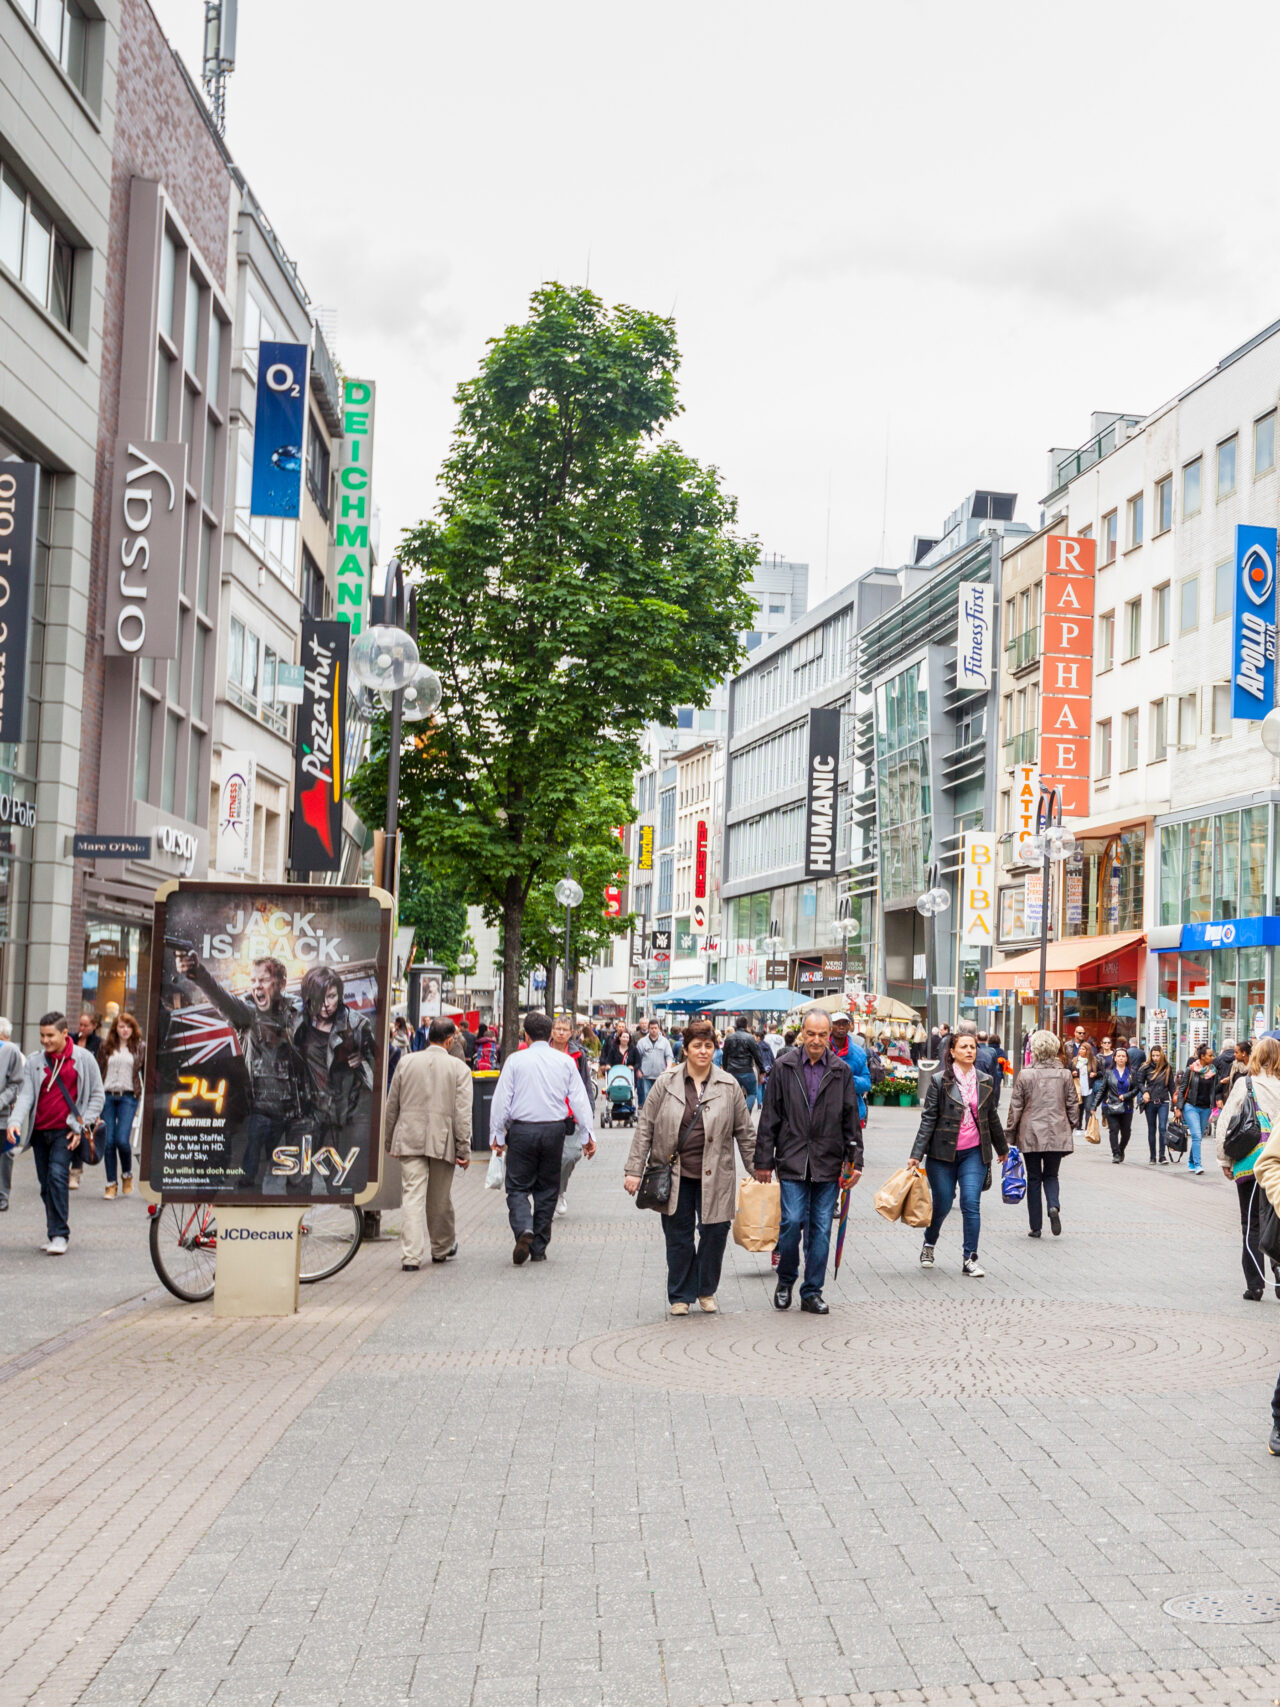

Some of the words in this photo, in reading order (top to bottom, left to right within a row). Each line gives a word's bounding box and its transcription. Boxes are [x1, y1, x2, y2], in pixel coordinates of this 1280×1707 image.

[336, 382, 371, 635] DEICHMANN
[117, 443, 175, 653] orsay
[1237, 612, 1265, 700] APOLLO
[1265, 622, 1276, 660] OPTIK
[303, 637, 332, 699] Hut
[1054, 539, 1084, 810] RAPHAEL
[302, 701, 332, 783] Pizza
[0, 794, 36, 828] O'Polo
[229, 783, 238, 818] FITNESS
[809, 754, 835, 871] HUMANIC
[77, 841, 106, 851] Marc
[109, 842, 145, 852] O'Polo
[162, 826, 199, 876] orsay
[638, 826, 653, 869] Fahrschule
[225, 911, 324, 937] JACK.
[202, 934, 241, 958] IS.
[249, 934, 349, 962] BACK.
[171, 1075, 226, 1116] 24
[165, 1133, 178, 1141] Die
[179, 1134, 198, 1142] neue
[199, 1133, 226, 1142] Staffel.
[166, 1117, 181, 1127] LIVE
[181, 1117, 211, 1127] ANOTHER
[212, 1117, 226, 1127] DAY
[164, 1142, 176, 1151] Ab
[177, 1143, 185, 1151] 6.
[187, 1143, 200, 1151] Mai
[202, 1143, 210, 1151] in
[211, 1143, 224, 1151] HD.
[164, 1152, 179, 1160] Nur
[179, 1152, 193, 1160] auf
[194, 1152, 208, 1162] Sky.
[271, 1134, 360, 1186] sky
[163, 1166, 174, 1175] Du
[175, 1167, 195, 1175] willst
[206, 1166, 224, 1175] doch
[225, 1167, 246, 1175] auch.
[219, 1228, 293, 1241] JCDecaux
